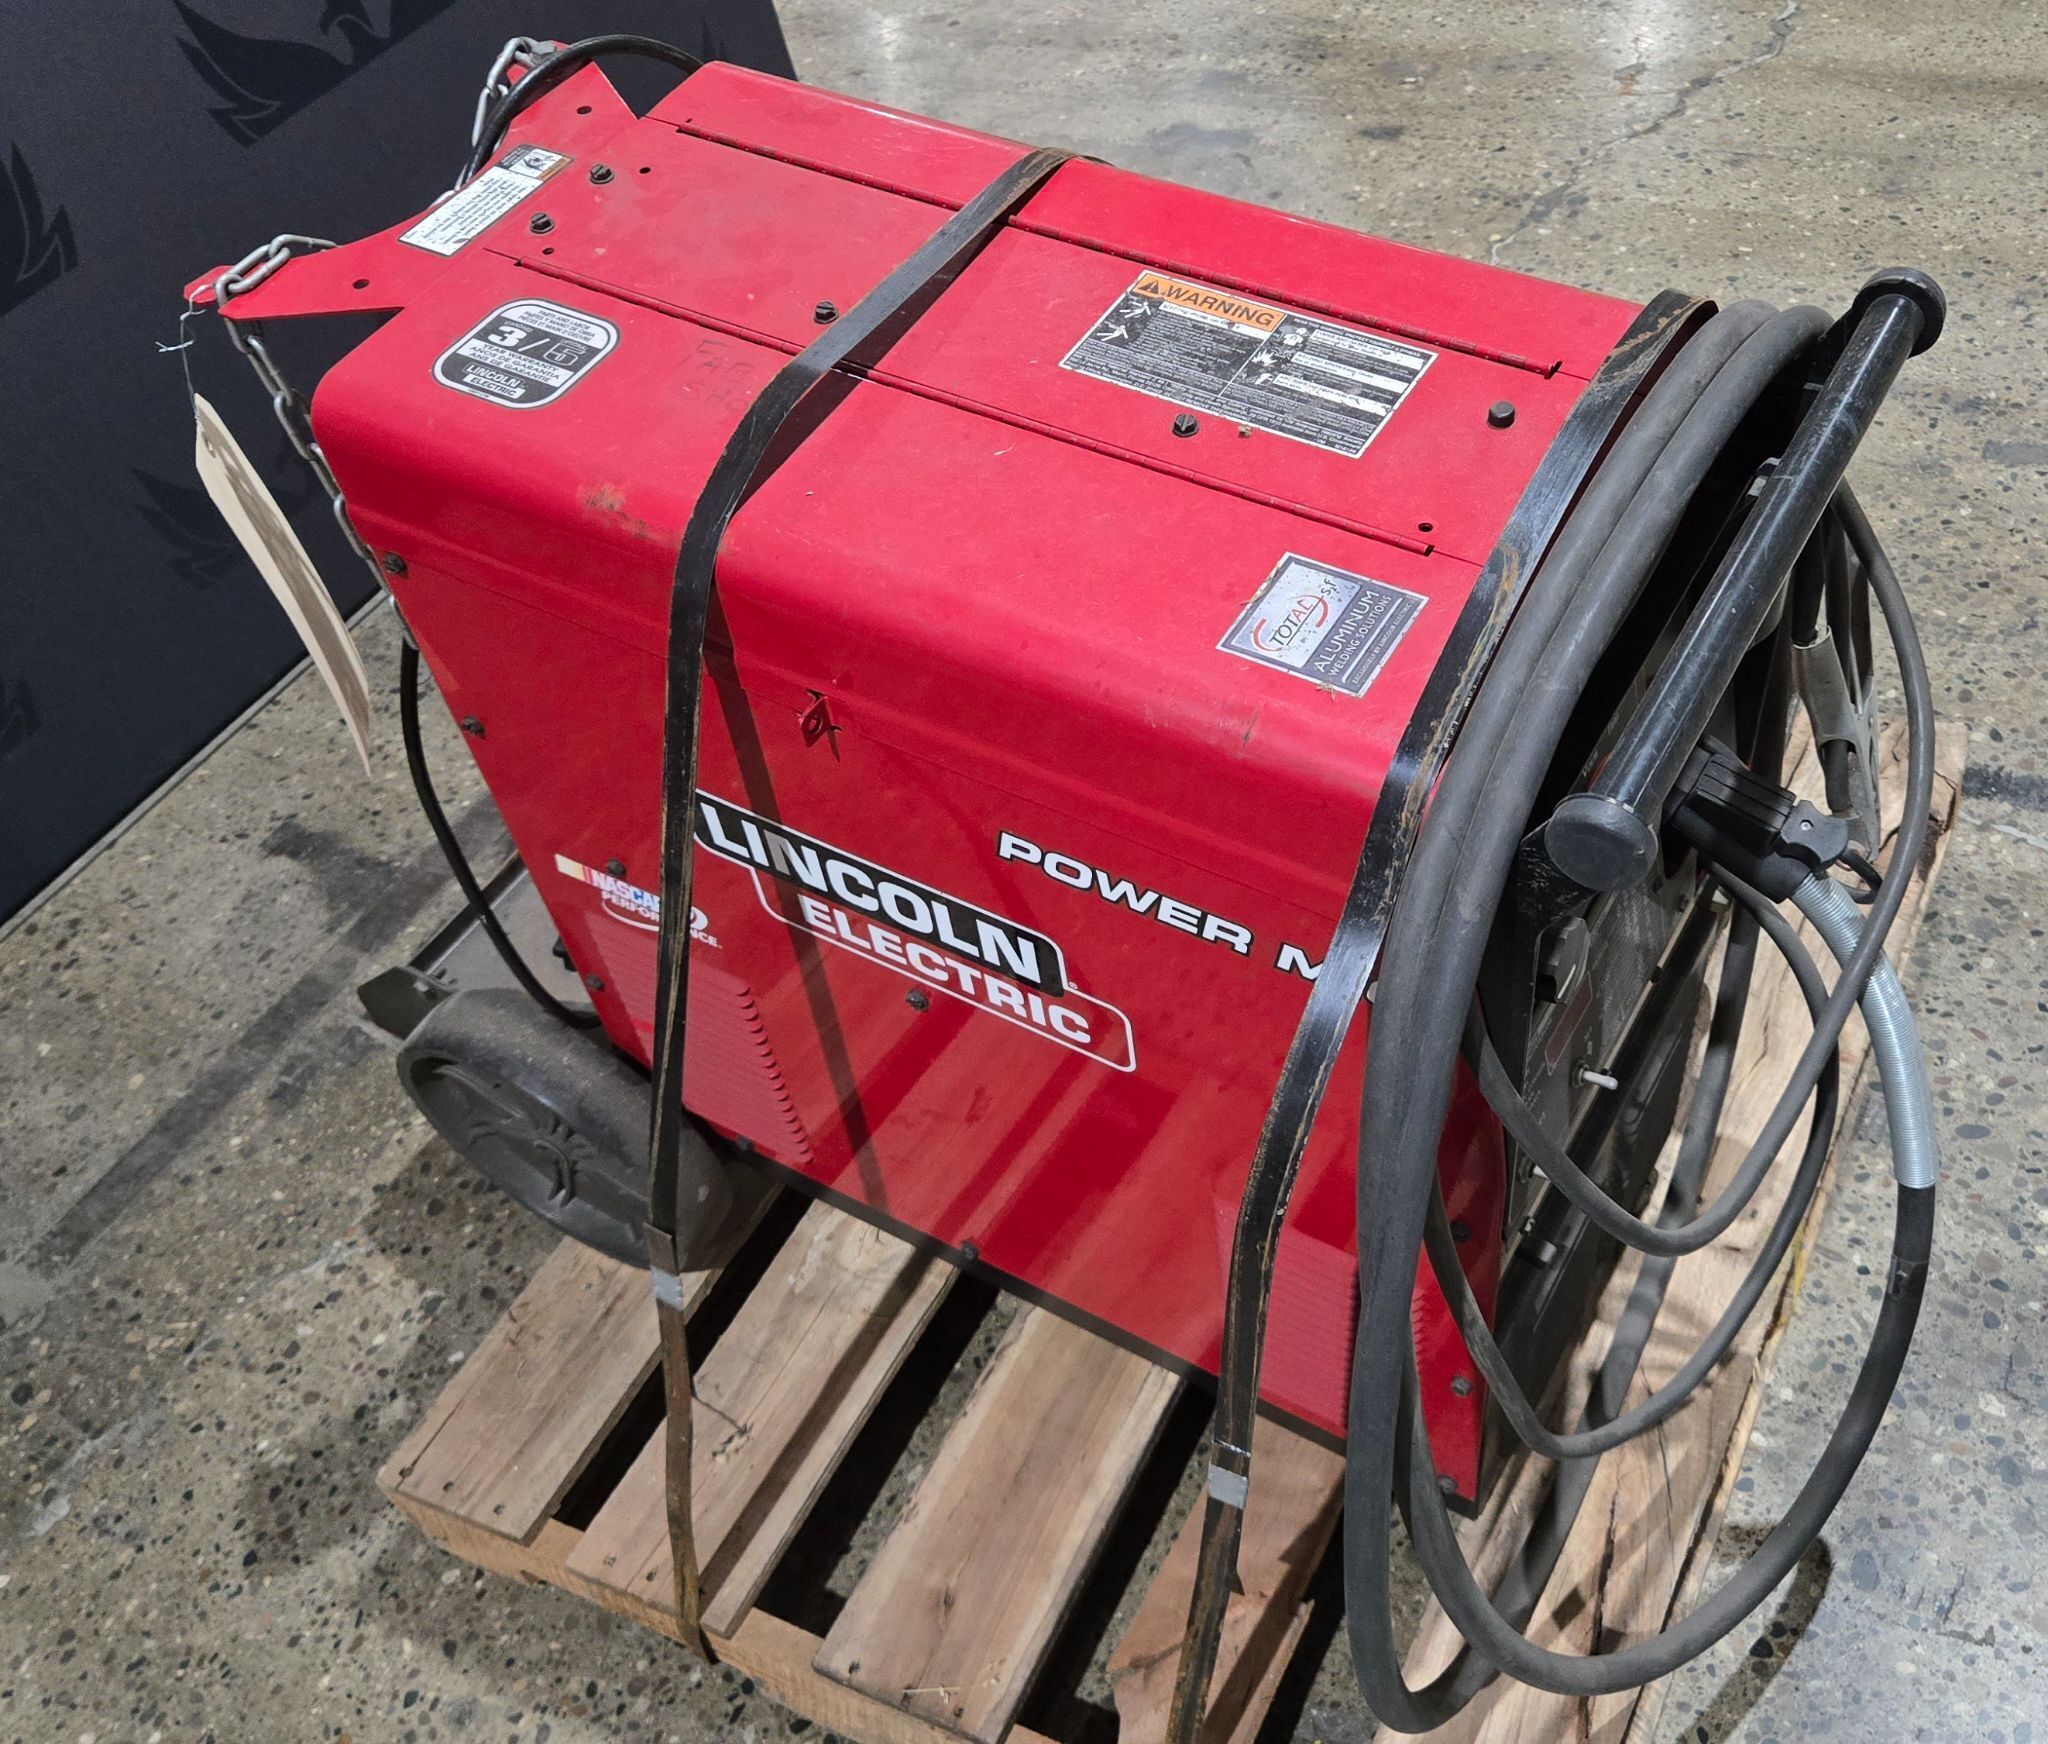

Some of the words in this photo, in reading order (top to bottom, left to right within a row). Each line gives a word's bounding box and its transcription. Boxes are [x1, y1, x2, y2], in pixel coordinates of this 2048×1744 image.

[1166, 285, 1275, 327] WARNING
[466, 364, 521, 388] LINCOLN
[469, 352, 490, 361] ANS
[504, 364, 551, 382] GARANTIE
[484, 344, 507, 355] YEAR
[509, 350, 559, 371] WARRANTY
[471, 377, 517, 396] ELECTRIC
[1269, 600, 1315, 646] TOTAL
[1314, 590, 1381, 673] ALUMINUM
[1328, 640, 1361, 677] WELDING
[1357, 595, 1392, 640] SOLUTIONS
[1373, 645, 1383, 655] BY
[1378, 625, 1397, 648] LINCOLN
[700, 803, 1043, 984] LINCOLN
[999, 831, 1253, 955] POWER
[601, 890, 718, 949] PERFORNCE
[798, 893, 1092, 1046] ELECTRIC
